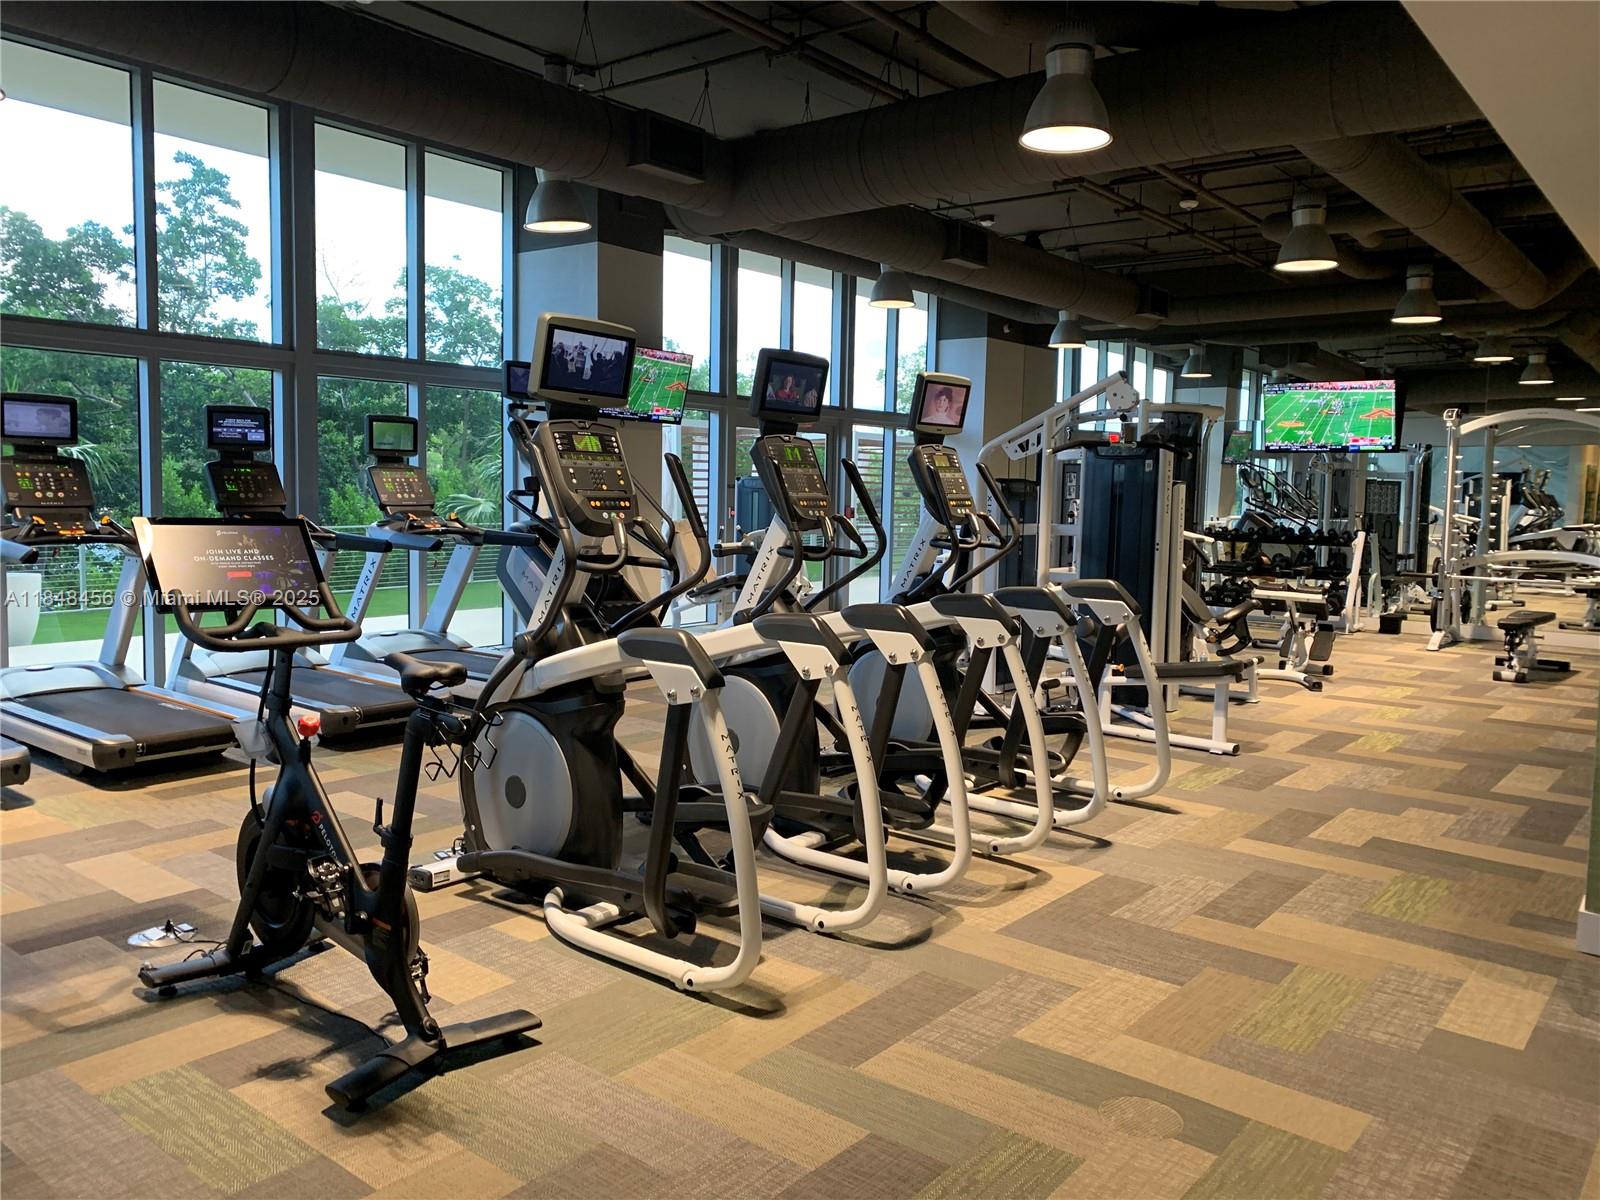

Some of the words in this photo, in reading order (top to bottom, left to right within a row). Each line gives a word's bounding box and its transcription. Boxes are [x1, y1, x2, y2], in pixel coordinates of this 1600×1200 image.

[351, 558, 377, 619] MATRIX
[537, 555, 566, 624] MATRIX
[747, 546, 774, 604] MATRIX
[901, 538, 926, 588] MATRIX
[851, 705, 873, 763] MATRIX
[935, 684, 956, 737] MATRIX
[721, 734, 745, 800] MATRIX
[318, 823, 338, 859] PELOTO
